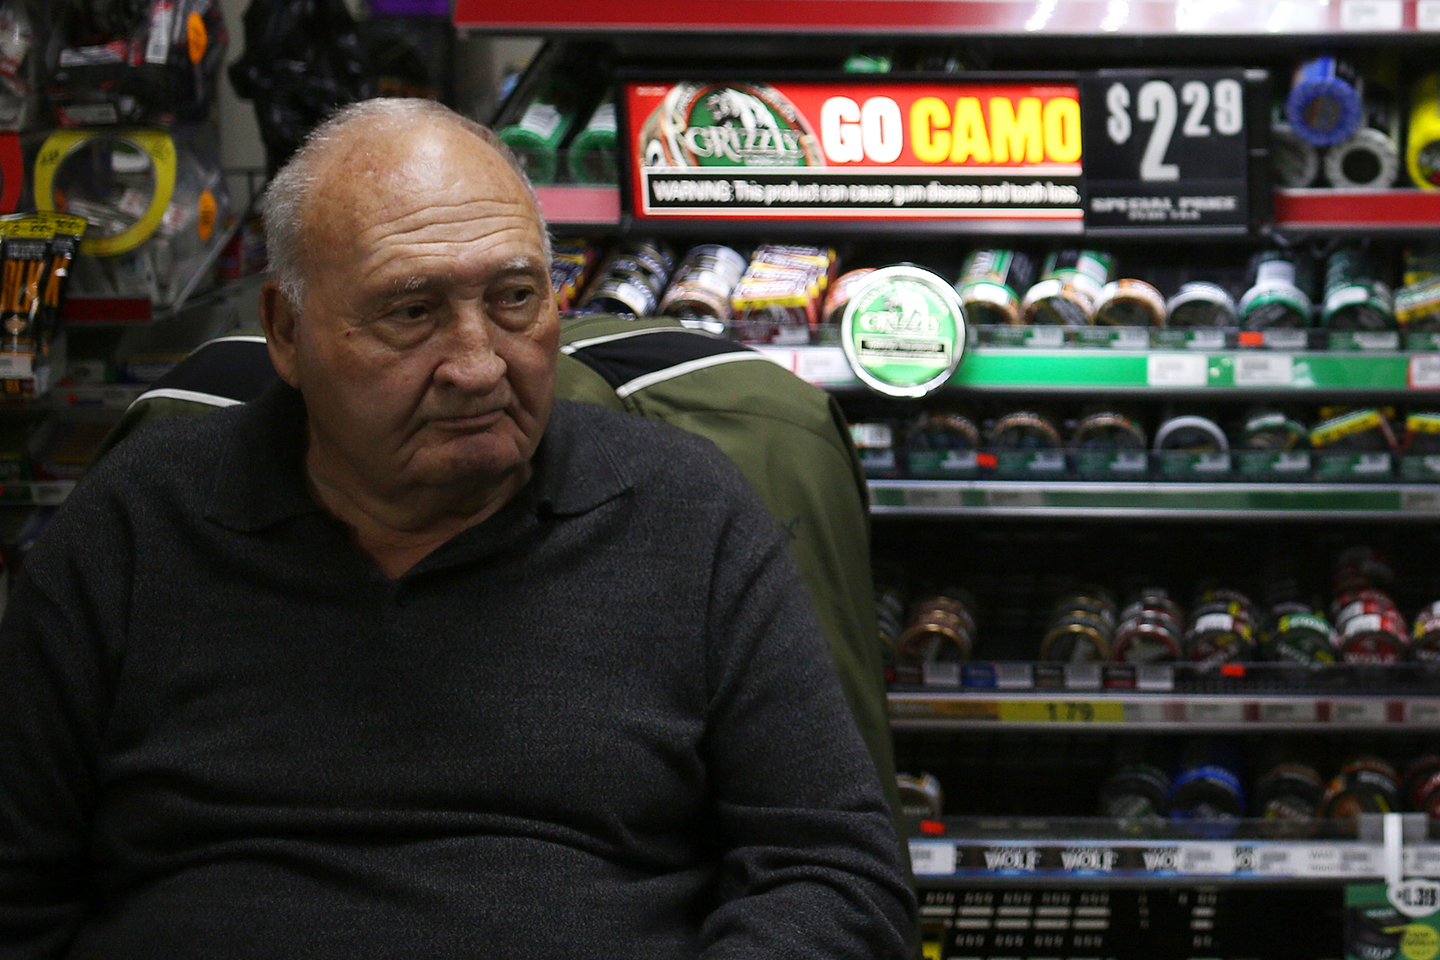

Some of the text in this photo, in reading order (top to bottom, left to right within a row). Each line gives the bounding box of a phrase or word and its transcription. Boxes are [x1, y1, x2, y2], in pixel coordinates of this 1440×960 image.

[819, 95, 1083, 164] GO CAMO
[653, 180, 735, 203] WARNING:
[735, 180, 764, 203] This
[764, 180, 820, 206] product
[820, 185, 849, 203] can
[849, 185, 893, 203] cause
[893, 185, 926, 206] gum
[926, 181, 981, 203] disease
[981, 181, 1009, 203] and
[1010, 181, 1048, 203] tooth
